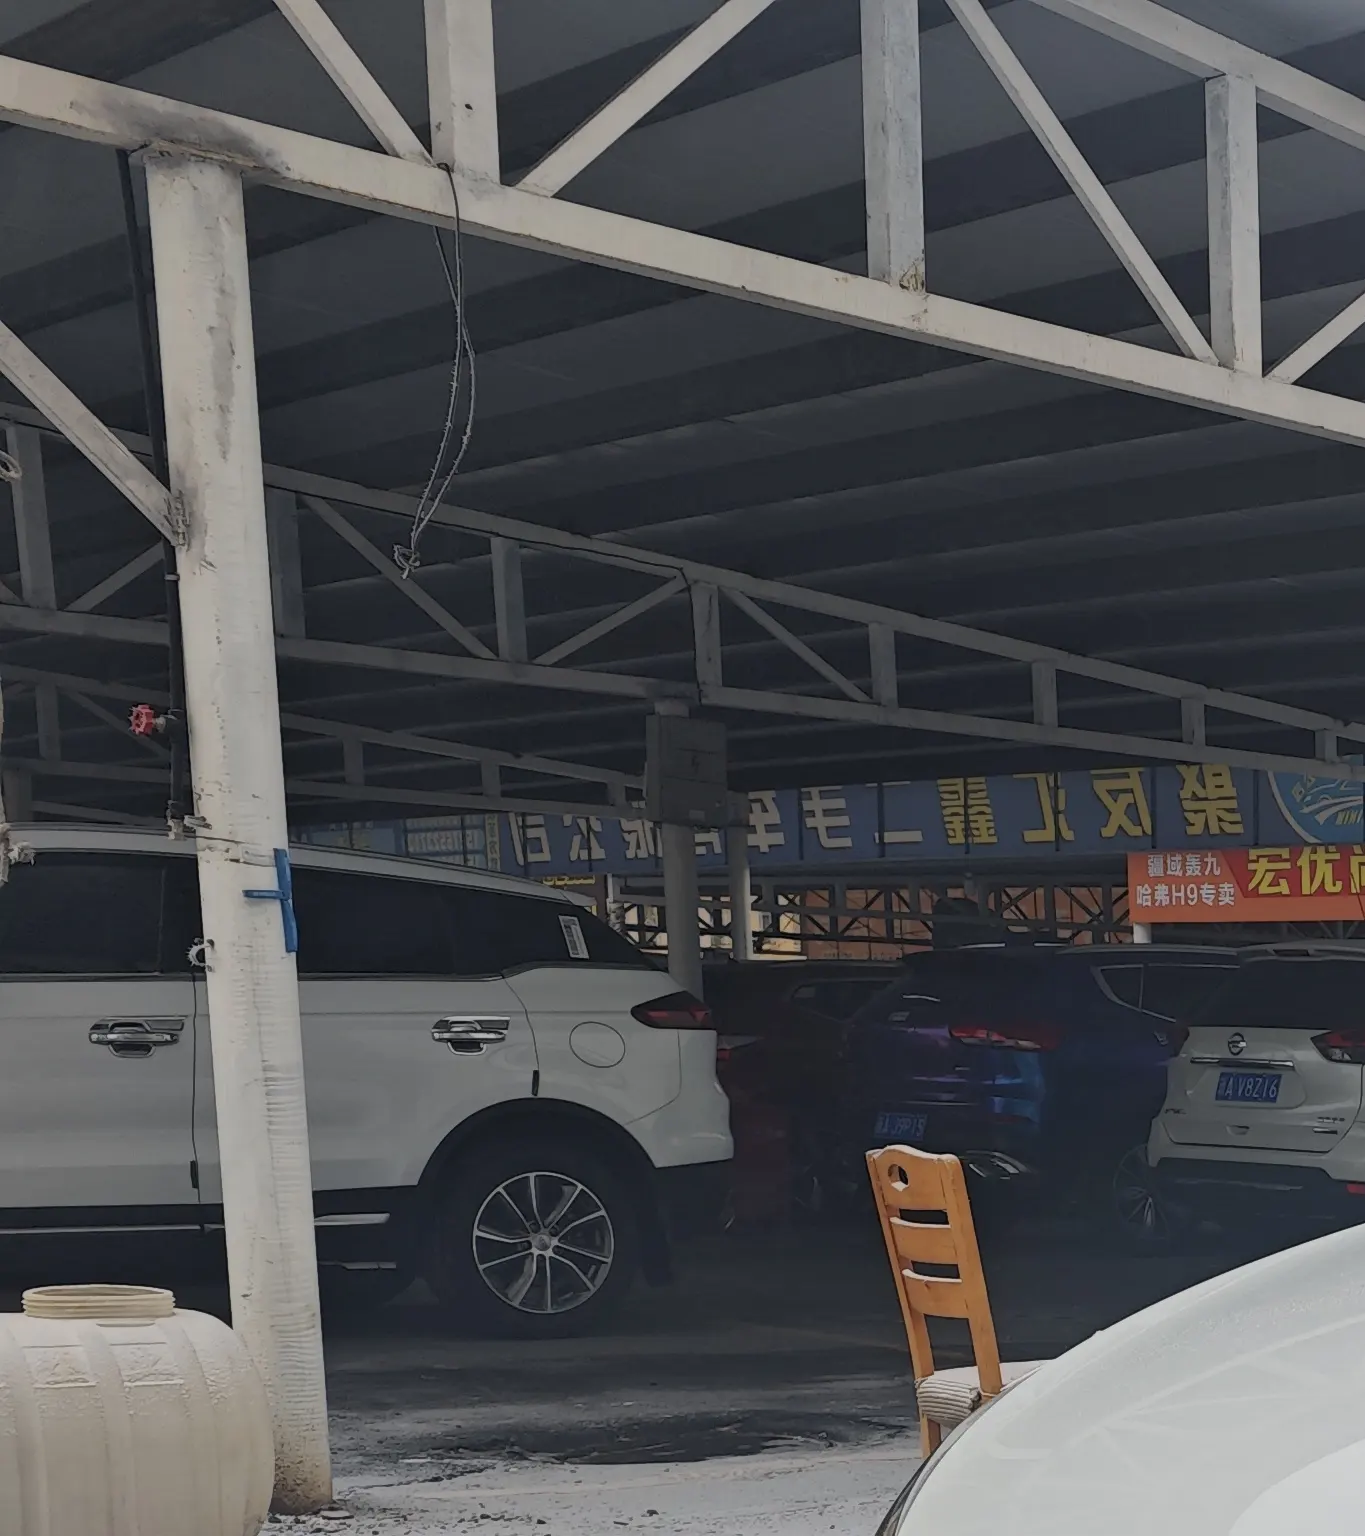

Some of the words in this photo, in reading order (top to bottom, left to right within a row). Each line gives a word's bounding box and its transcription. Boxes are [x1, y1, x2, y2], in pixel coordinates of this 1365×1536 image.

[1147, 852, 1222, 878] 疆域轰九
[1136, 882, 1236, 908] 哈弗H9专卖
